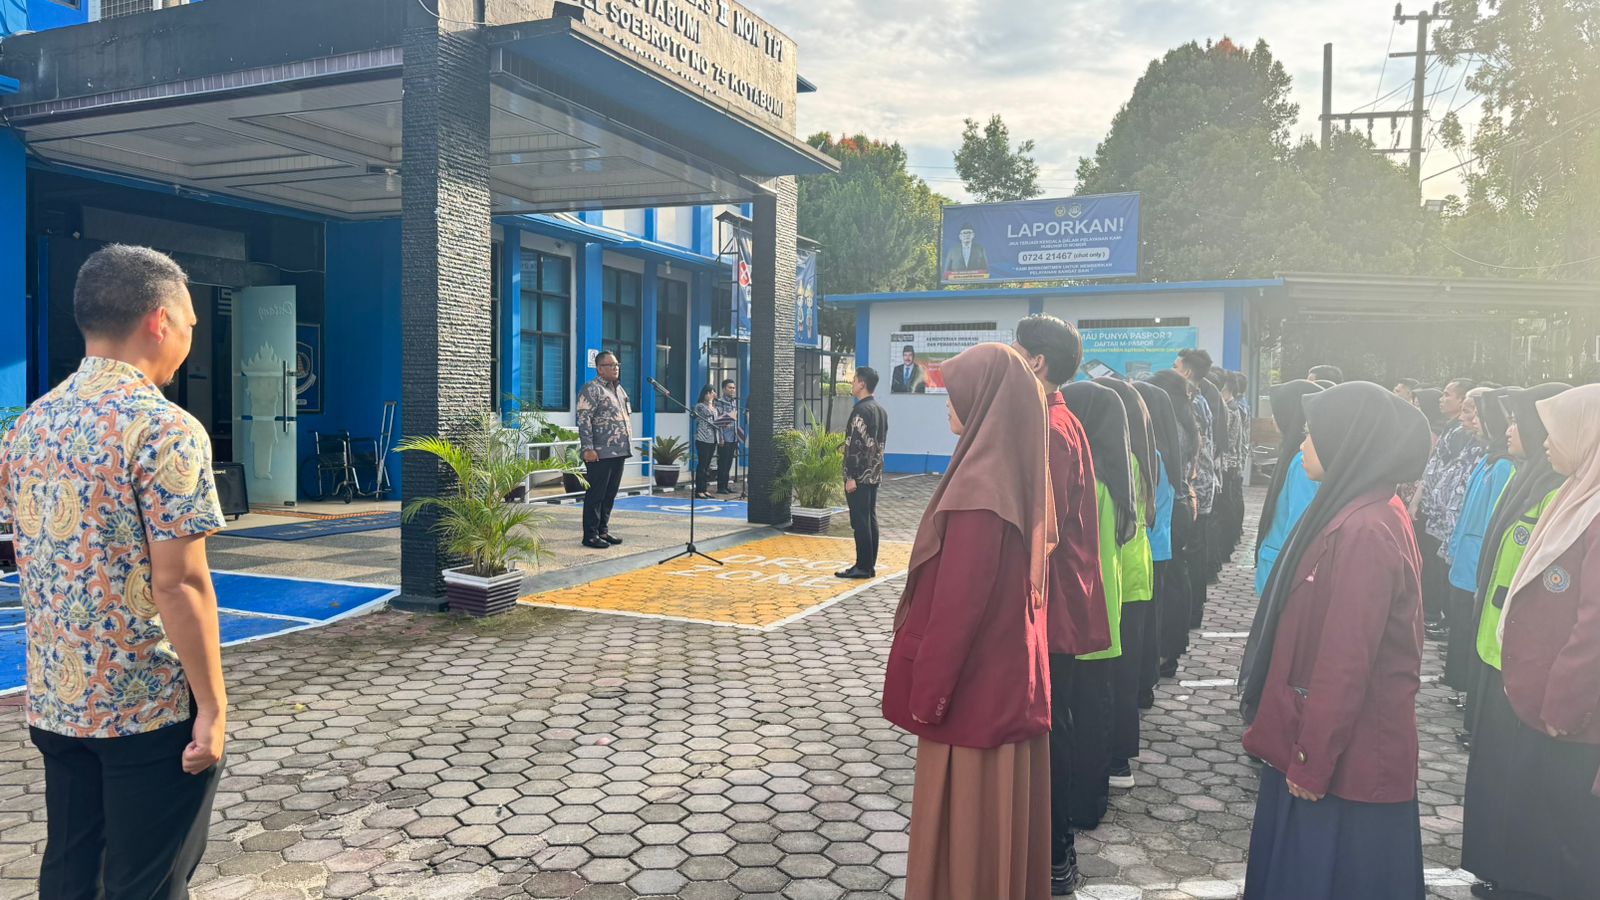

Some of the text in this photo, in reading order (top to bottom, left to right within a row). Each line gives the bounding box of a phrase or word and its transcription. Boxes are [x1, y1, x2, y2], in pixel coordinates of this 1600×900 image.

[734, 10, 760, 48] NON
[764, 31, 784, 62] TPI
[607, 1, 688, 62] SOEBROTO
[690, 50, 708, 74] NO
[712, 63, 726, 85] 75
[729, 72, 784, 118] KOTABUMI
[1007, 217, 1124, 238] LAPORKAN!
[1022, 253, 1043, 262] 0724
[1046, 252, 1072, 261] 21467
[1099, 332, 1128, 340] PUNYA
[1129, 331, 1165, 340] PASPOR
[1119, 339, 1154, 347] M-PASPOR
